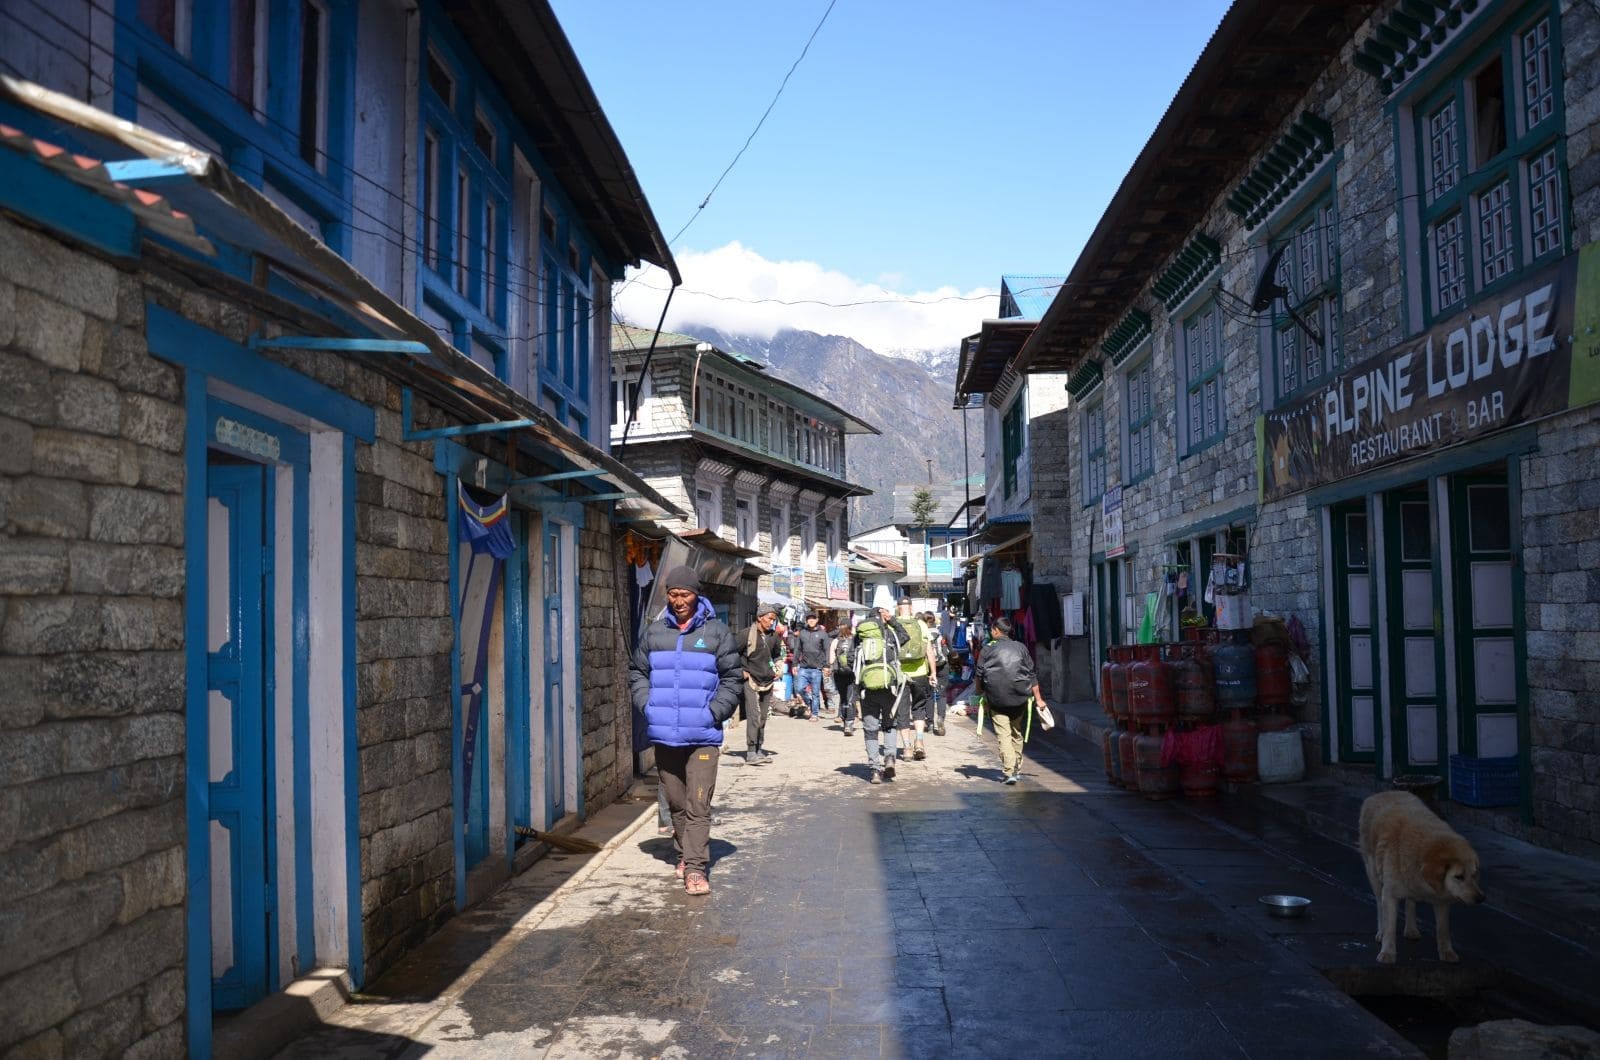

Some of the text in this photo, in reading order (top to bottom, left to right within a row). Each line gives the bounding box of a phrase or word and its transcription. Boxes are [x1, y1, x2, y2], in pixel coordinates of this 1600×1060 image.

[1324, 284, 1556, 445] ALPINE LODGE
[1351, 391, 1504, 466] RESTAURANT & BAR
